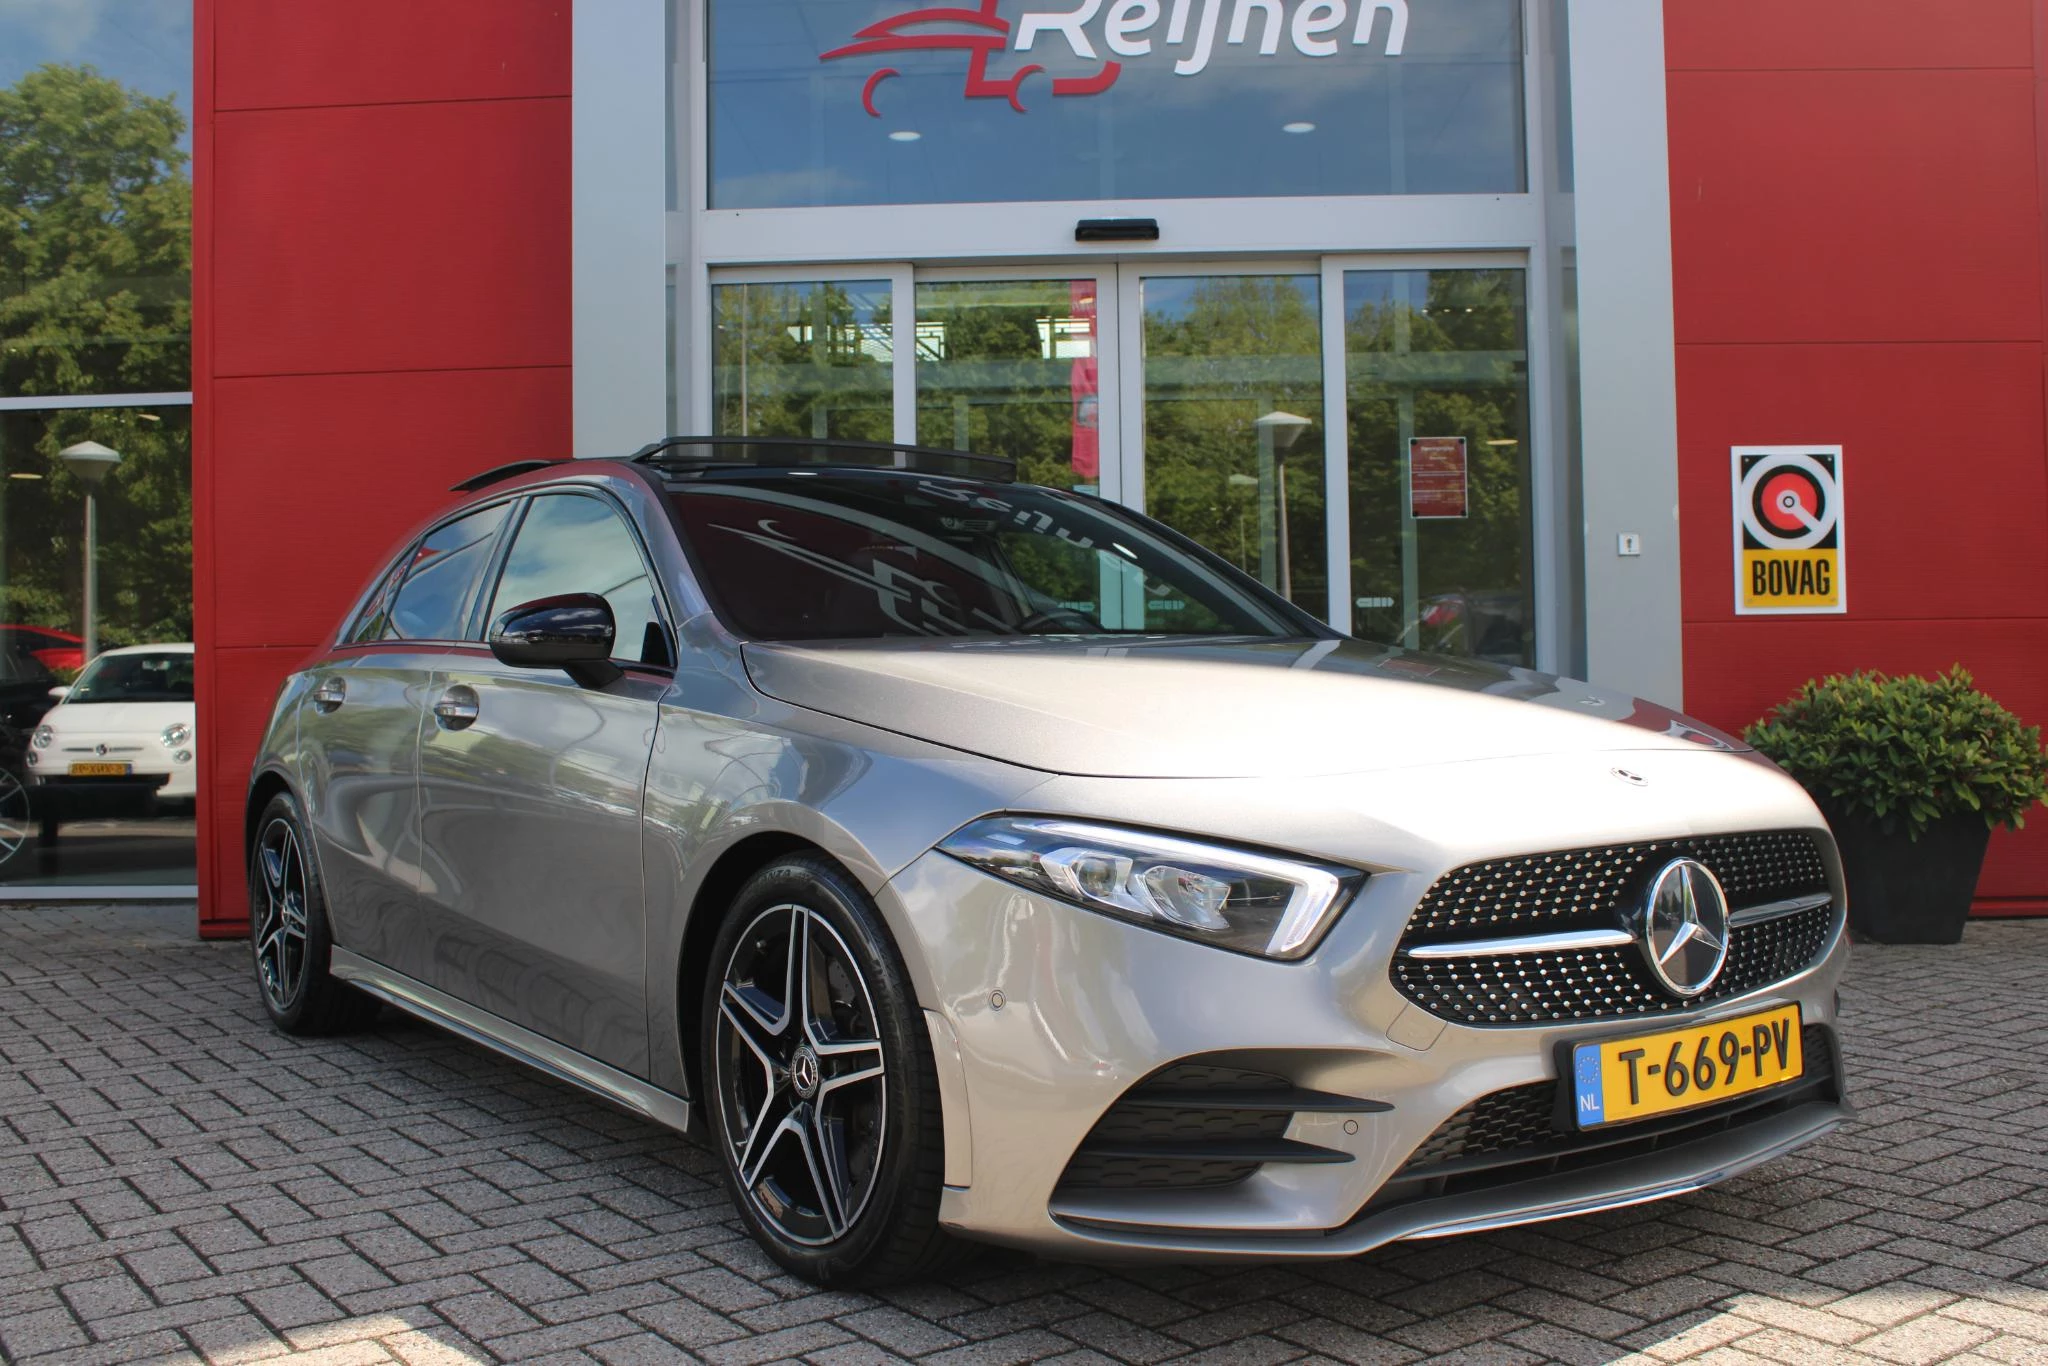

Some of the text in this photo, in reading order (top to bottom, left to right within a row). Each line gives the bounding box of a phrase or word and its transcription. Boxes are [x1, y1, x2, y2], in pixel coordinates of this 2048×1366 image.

[1014, 0, 1408, 75] Reijnen
[1752, 559, 1830, 596] BOVAG
[1619, 1018, 1790, 1105] T-669-PV
[1580, 1094, 1600, 1112] NL
